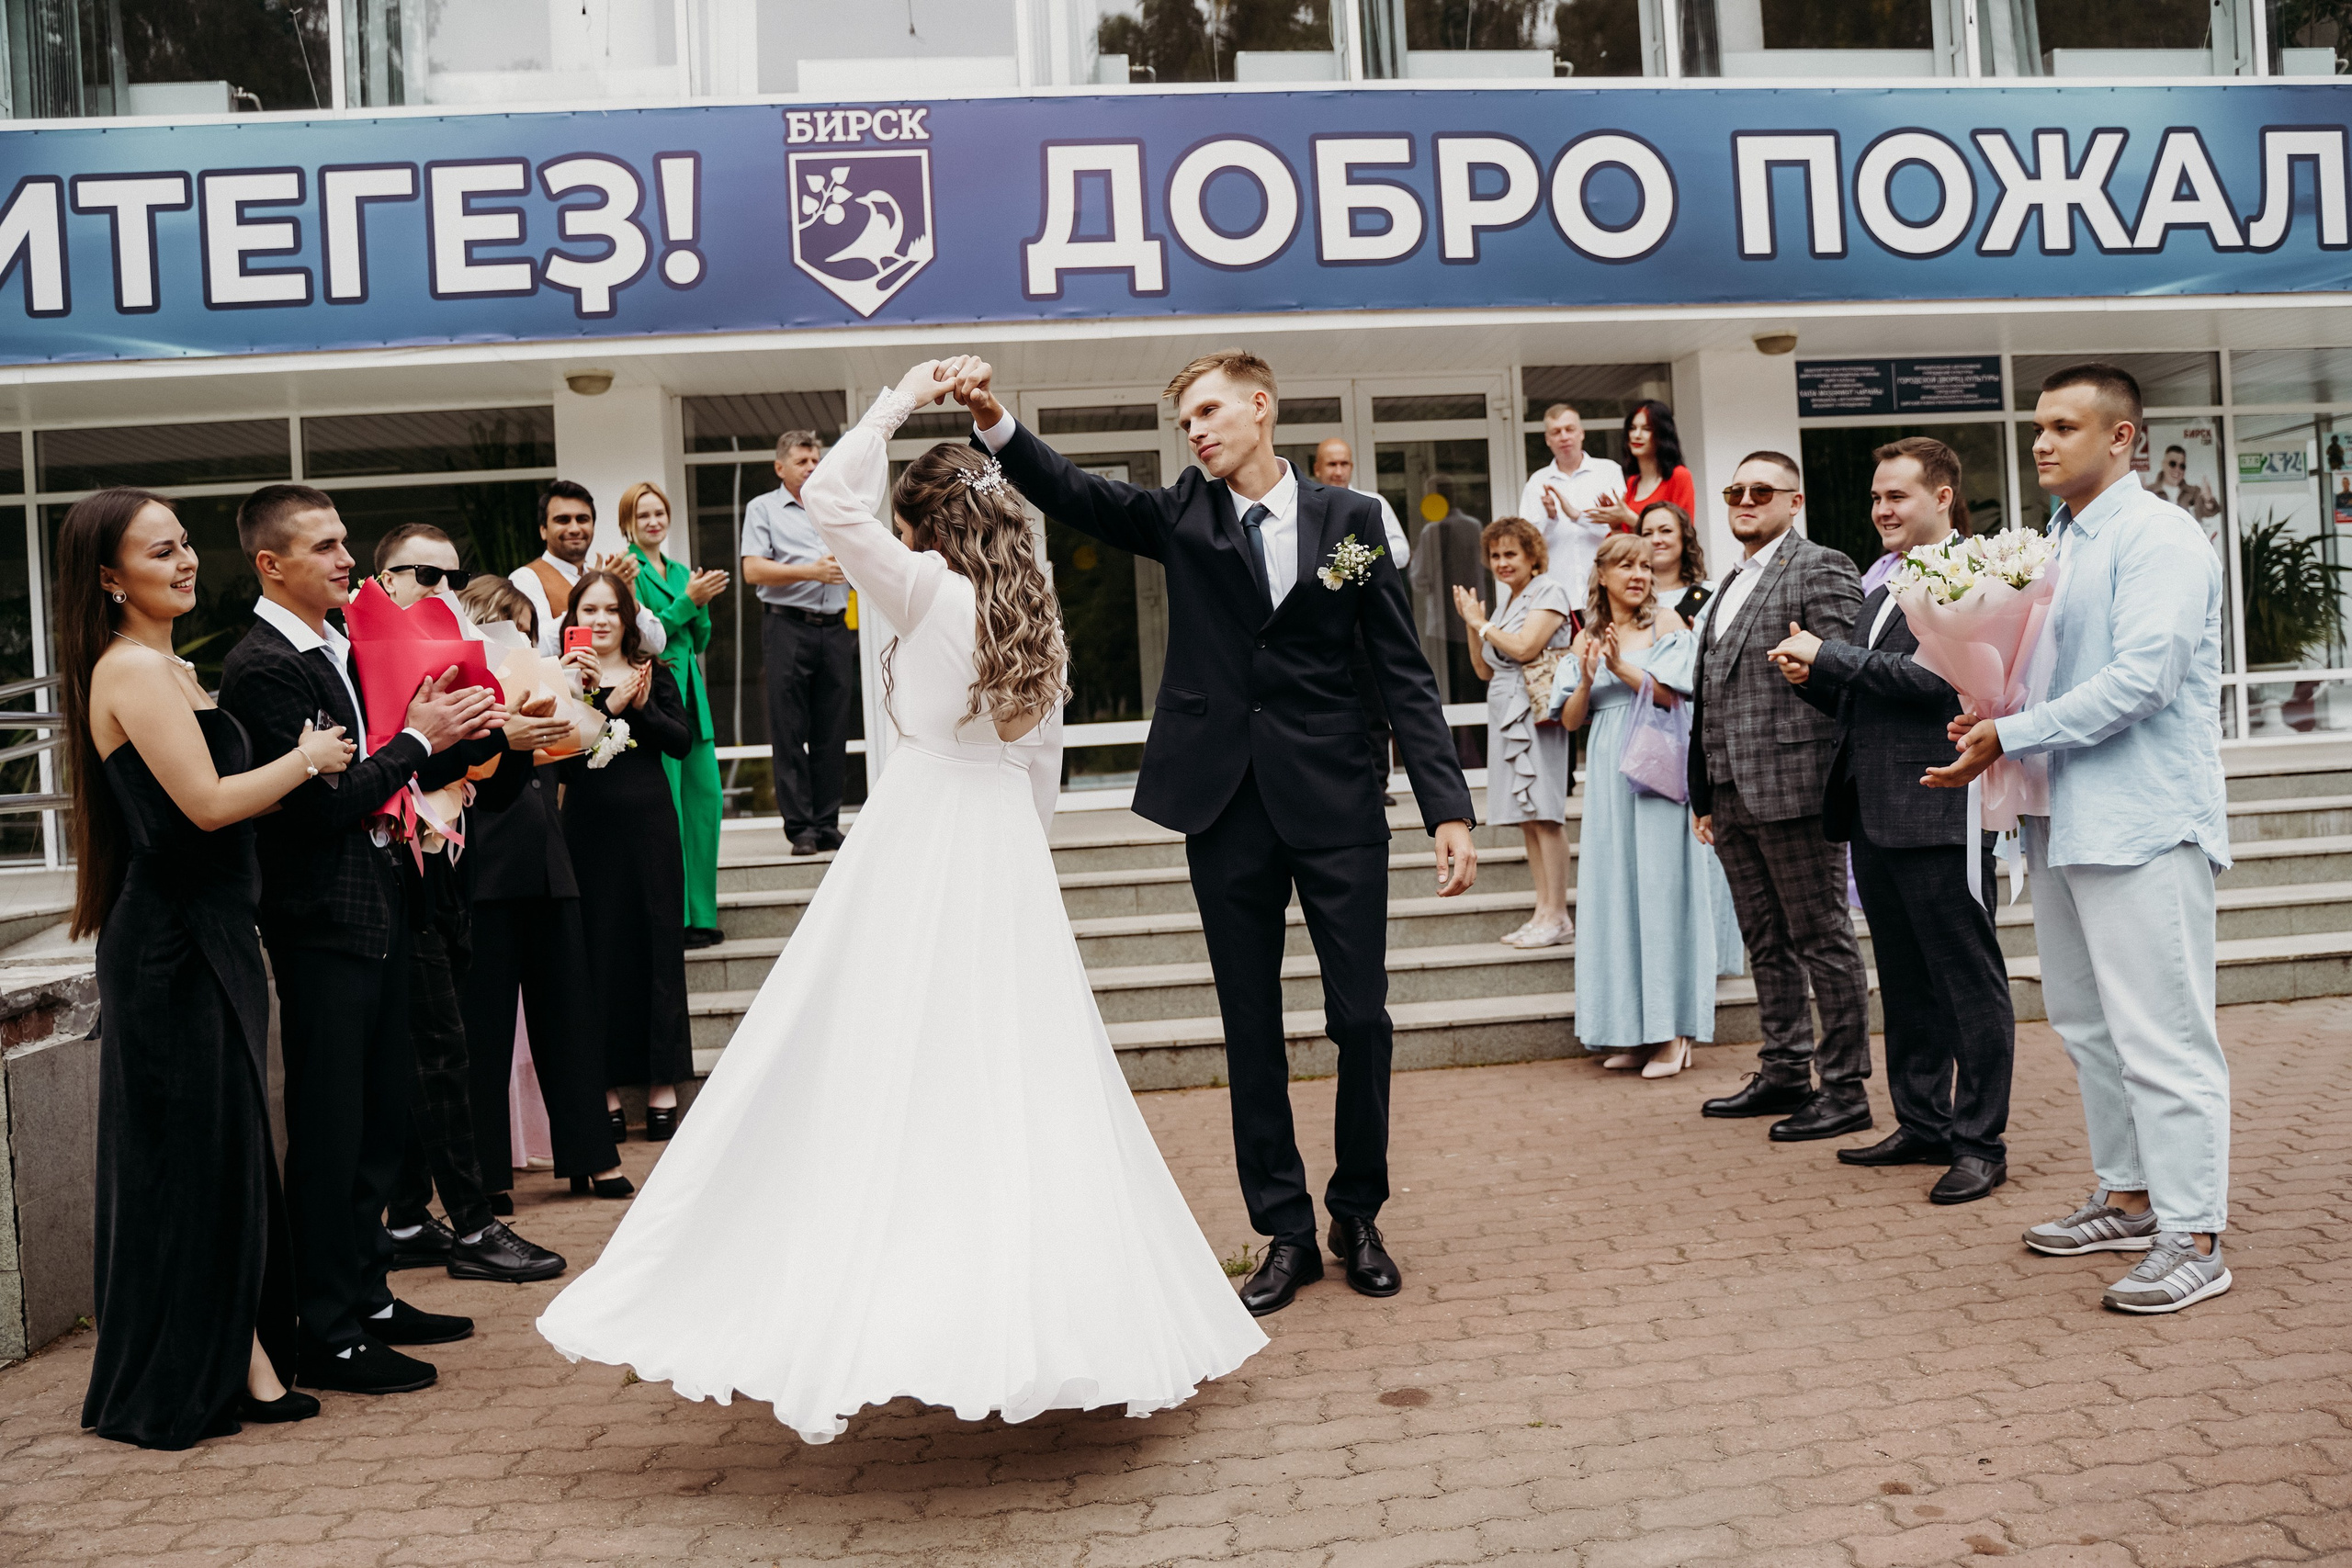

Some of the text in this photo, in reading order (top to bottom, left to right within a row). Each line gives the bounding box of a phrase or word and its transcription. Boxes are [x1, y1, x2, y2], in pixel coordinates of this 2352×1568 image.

[785, 107, 931, 144] БИРСК
[1026, 130, 2348, 295] ДОБРО ПОЖАЛ
